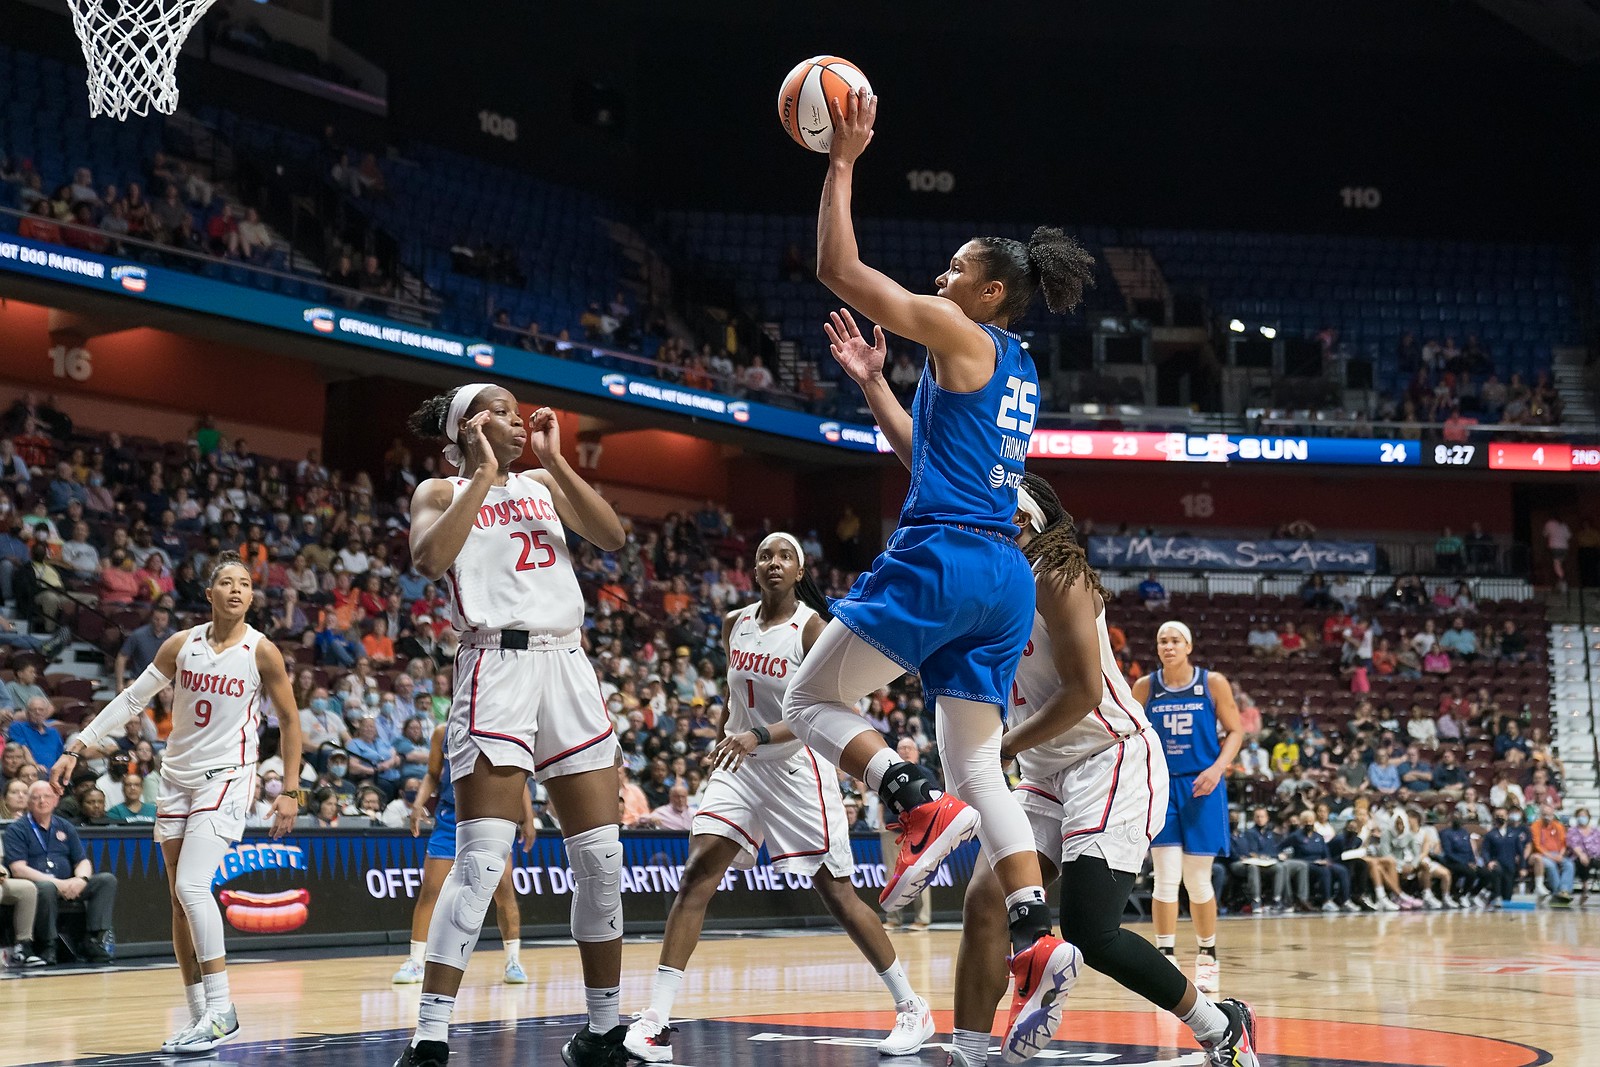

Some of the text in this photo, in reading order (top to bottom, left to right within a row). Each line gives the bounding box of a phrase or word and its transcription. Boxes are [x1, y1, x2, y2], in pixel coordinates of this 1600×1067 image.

[478, 109, 517, 141] 108
[907, 170, 955, 193] 109
[1340, 186, 1381, 208] 110
[20, 246, 48, 266] DOG
[48, 252, 105, 279] PARTNER
[339, 317, 383, 340] OFFICIAL
[382, 326, 402, 343] HOT
[421, 335, 465, 357] PARTNER
[48, 344, 93, 381] 16
[997, 375, 1037, 435] 25
[575, 442, 602, 470] 17
[1027, 434, 1138, 456] TICS 23
[1238, 438, 1407, 463] SUN 24
[1434, 445, 1475, 465] 8:27
[1531, 447, 1600, 465] 4 2ND
[510, 530, 557, 572] 25
[1125, 536, 1370, 570] Mohegan Sun Arena
[745, 678, 755, 708] 1
[194, 699, 213, 728] 9
[1152, 703, 1204, 713] KEESUSK
[1163, 713, 1194, 736] 42
[512, 866, 543, 895] OT
